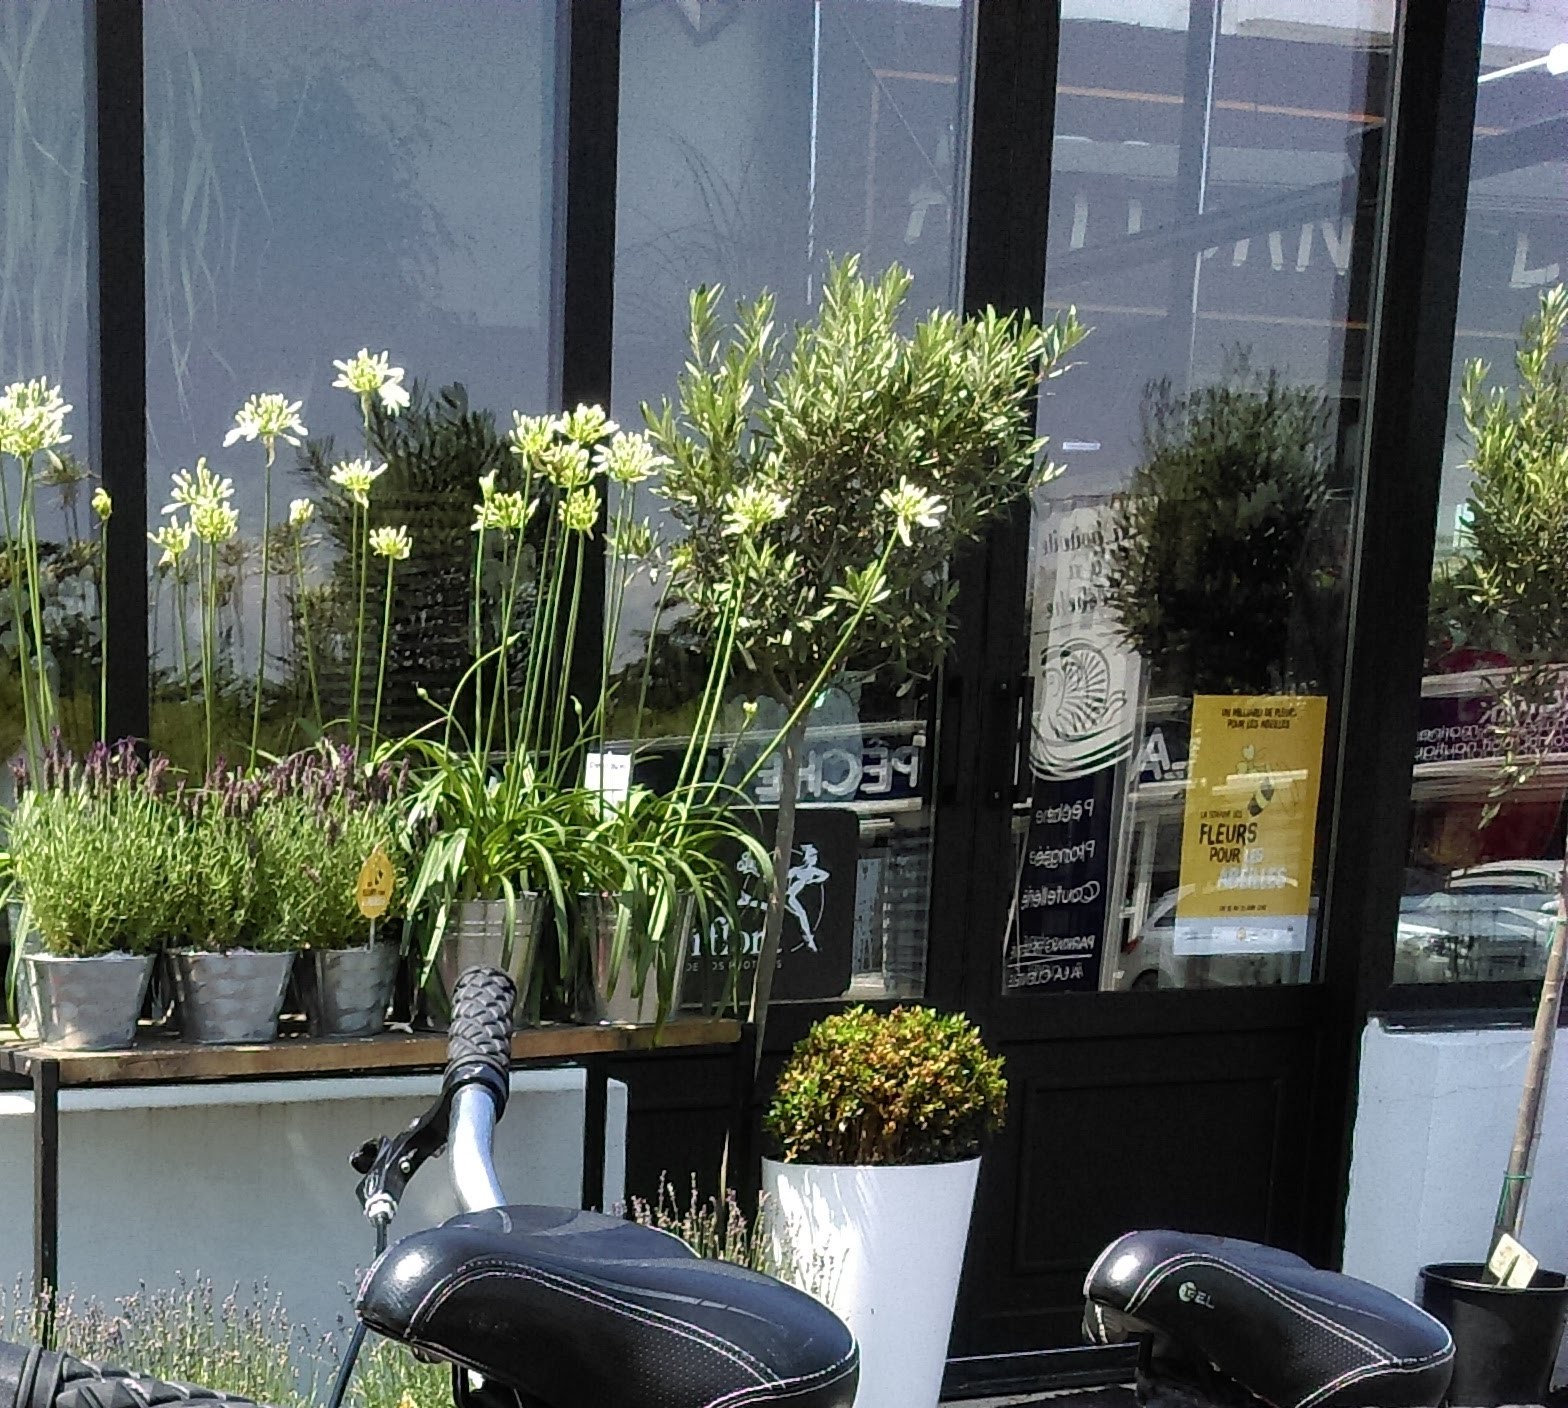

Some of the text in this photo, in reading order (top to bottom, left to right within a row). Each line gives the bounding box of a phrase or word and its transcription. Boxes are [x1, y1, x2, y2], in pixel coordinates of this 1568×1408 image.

[1199, 822, 1258, 846] FLEURS
[1209, 847, 1241, 863] POUR
[1185, 1283, 1216, 1309] GEL
